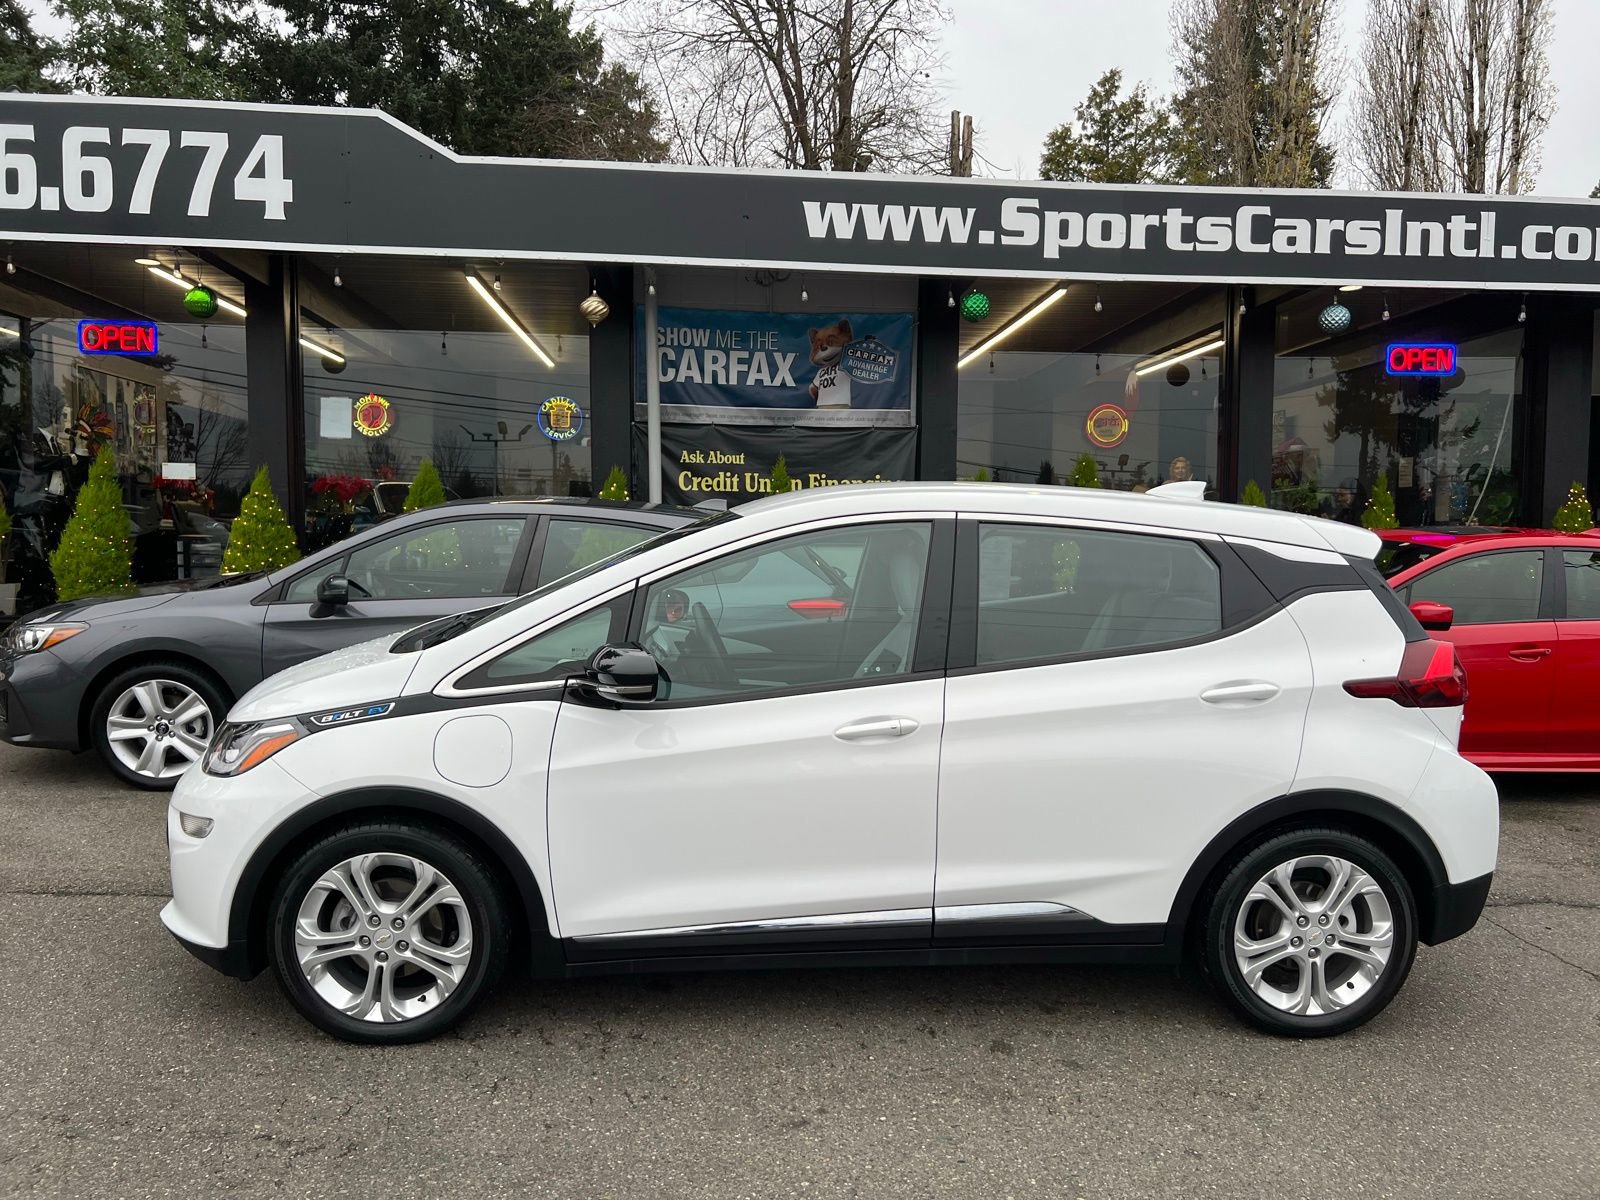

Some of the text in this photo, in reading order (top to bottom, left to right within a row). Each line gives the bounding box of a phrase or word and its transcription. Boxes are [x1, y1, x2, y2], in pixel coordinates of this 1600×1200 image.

[0, 123, 293, 220] 6.6774
[802, 197, 1600, 261] www.SportsCarsIntl.co
[82, 324, 155, 352] OPEN
[656, 327, 778, 350] SHOW ME THE
[847, 349, 894, 366] CARFAX
[1390, 347, 1452, 371] OPEN
[658, 347, 796, 387] CARFAX
[819, 365, 838, 378] CAR
[848, 359, 888, 373] ADVANTAGE
[819, 376, 837, 389] FOX
[852, 369, 880, 380] DEALER
[354, 395, 390, 409] MOHAWK
[541, 397, 580, 413] CADILLAC
[353, 420, 391, 436] GASOLINE
[545, 427, 576, 439] SERVICE
[680, 450, 745, 465] Ask About
[678, 471, 739, 492] Credit
[745, 472, 802, 493] Unn
[321, 705, 388, 722] BOLT EV
